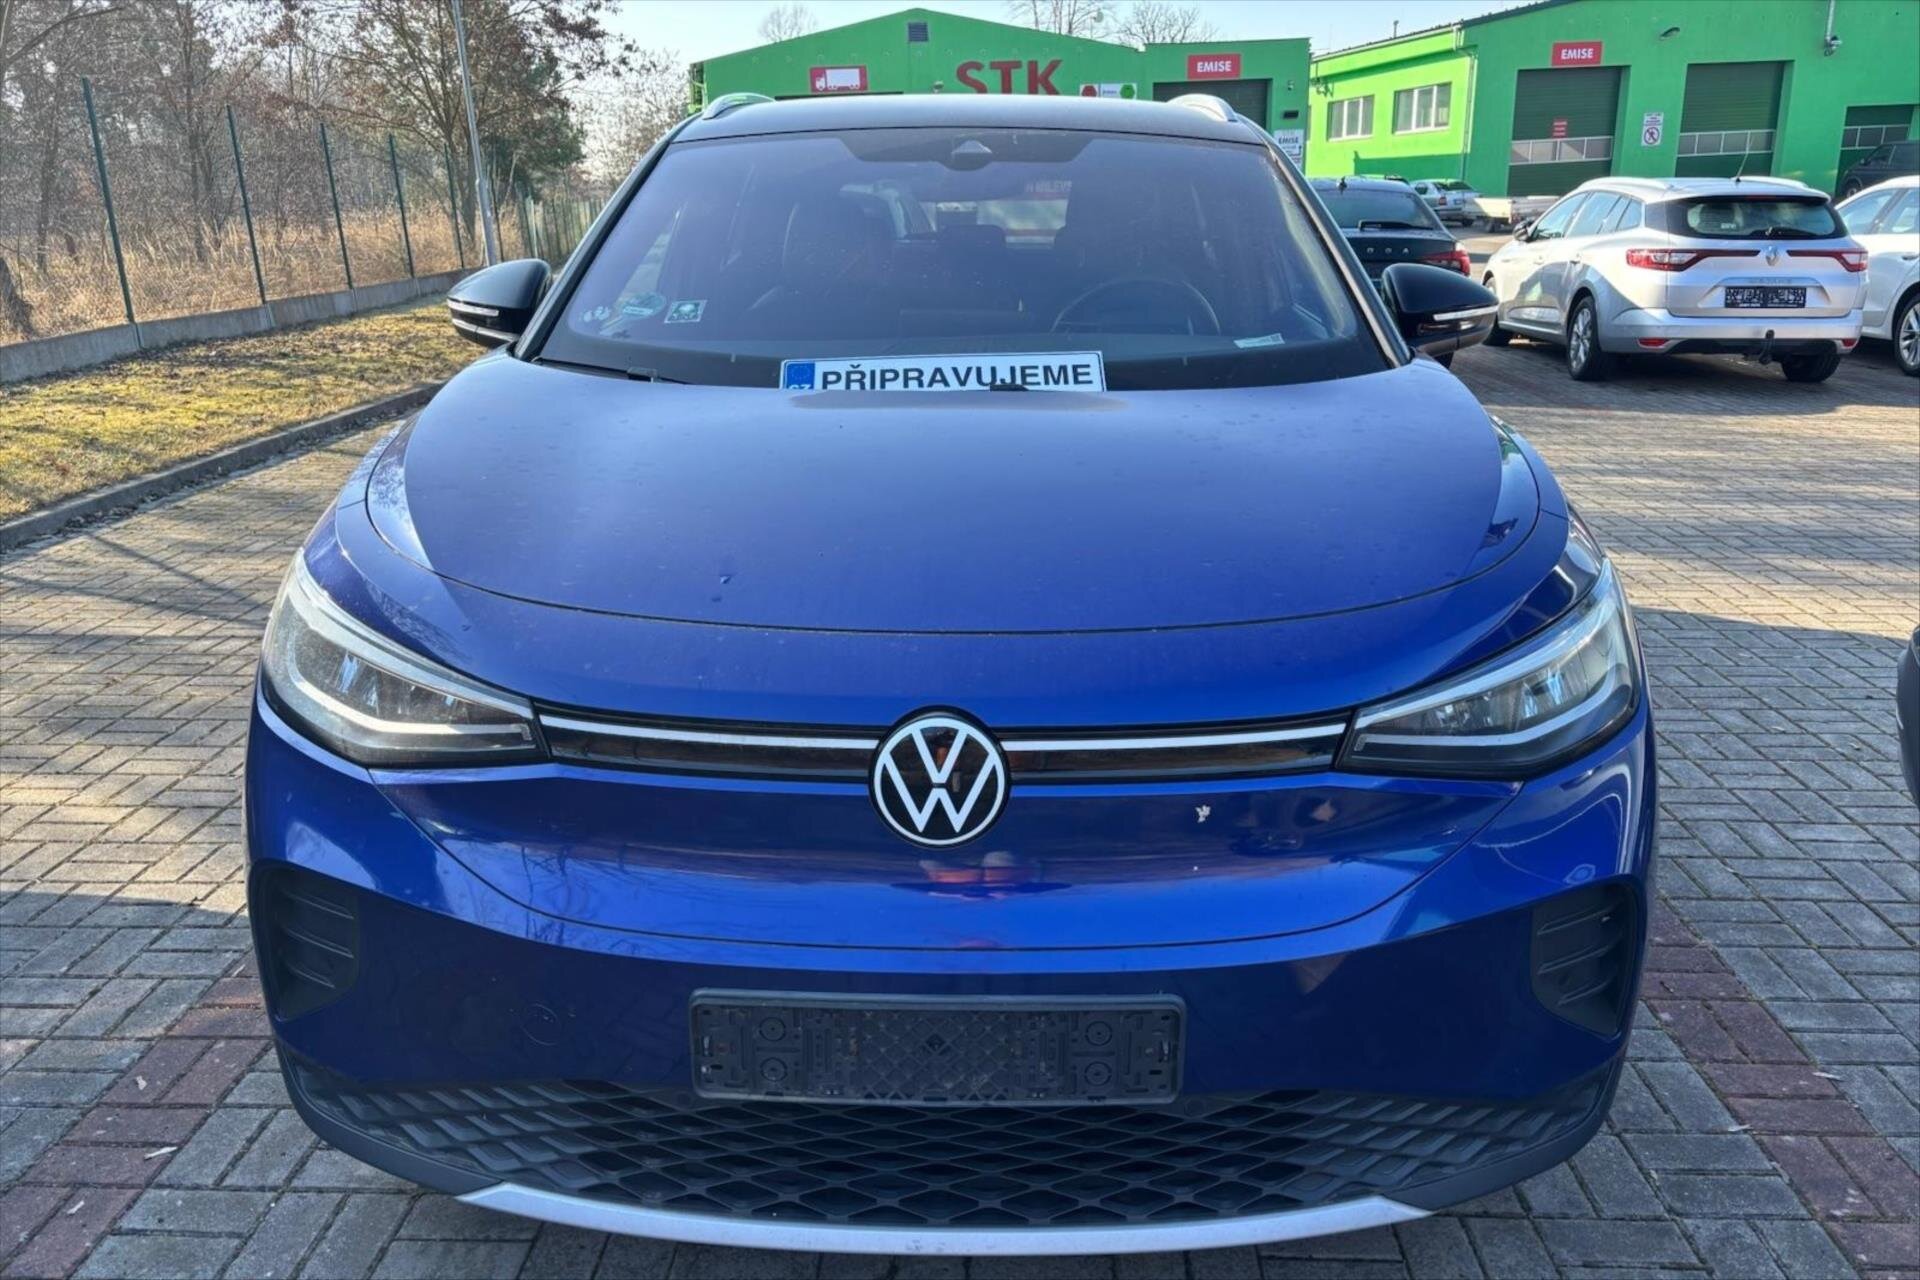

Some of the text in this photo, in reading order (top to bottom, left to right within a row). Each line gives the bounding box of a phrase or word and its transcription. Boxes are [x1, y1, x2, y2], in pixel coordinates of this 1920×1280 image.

[1561, 48, 1594, 59] EMISE
[1197, 61, 1232, 72] EMISE
[956, 60, 1063, 96] STK
[822, 364, 1093, 390] PŘIPRAVUJEME
